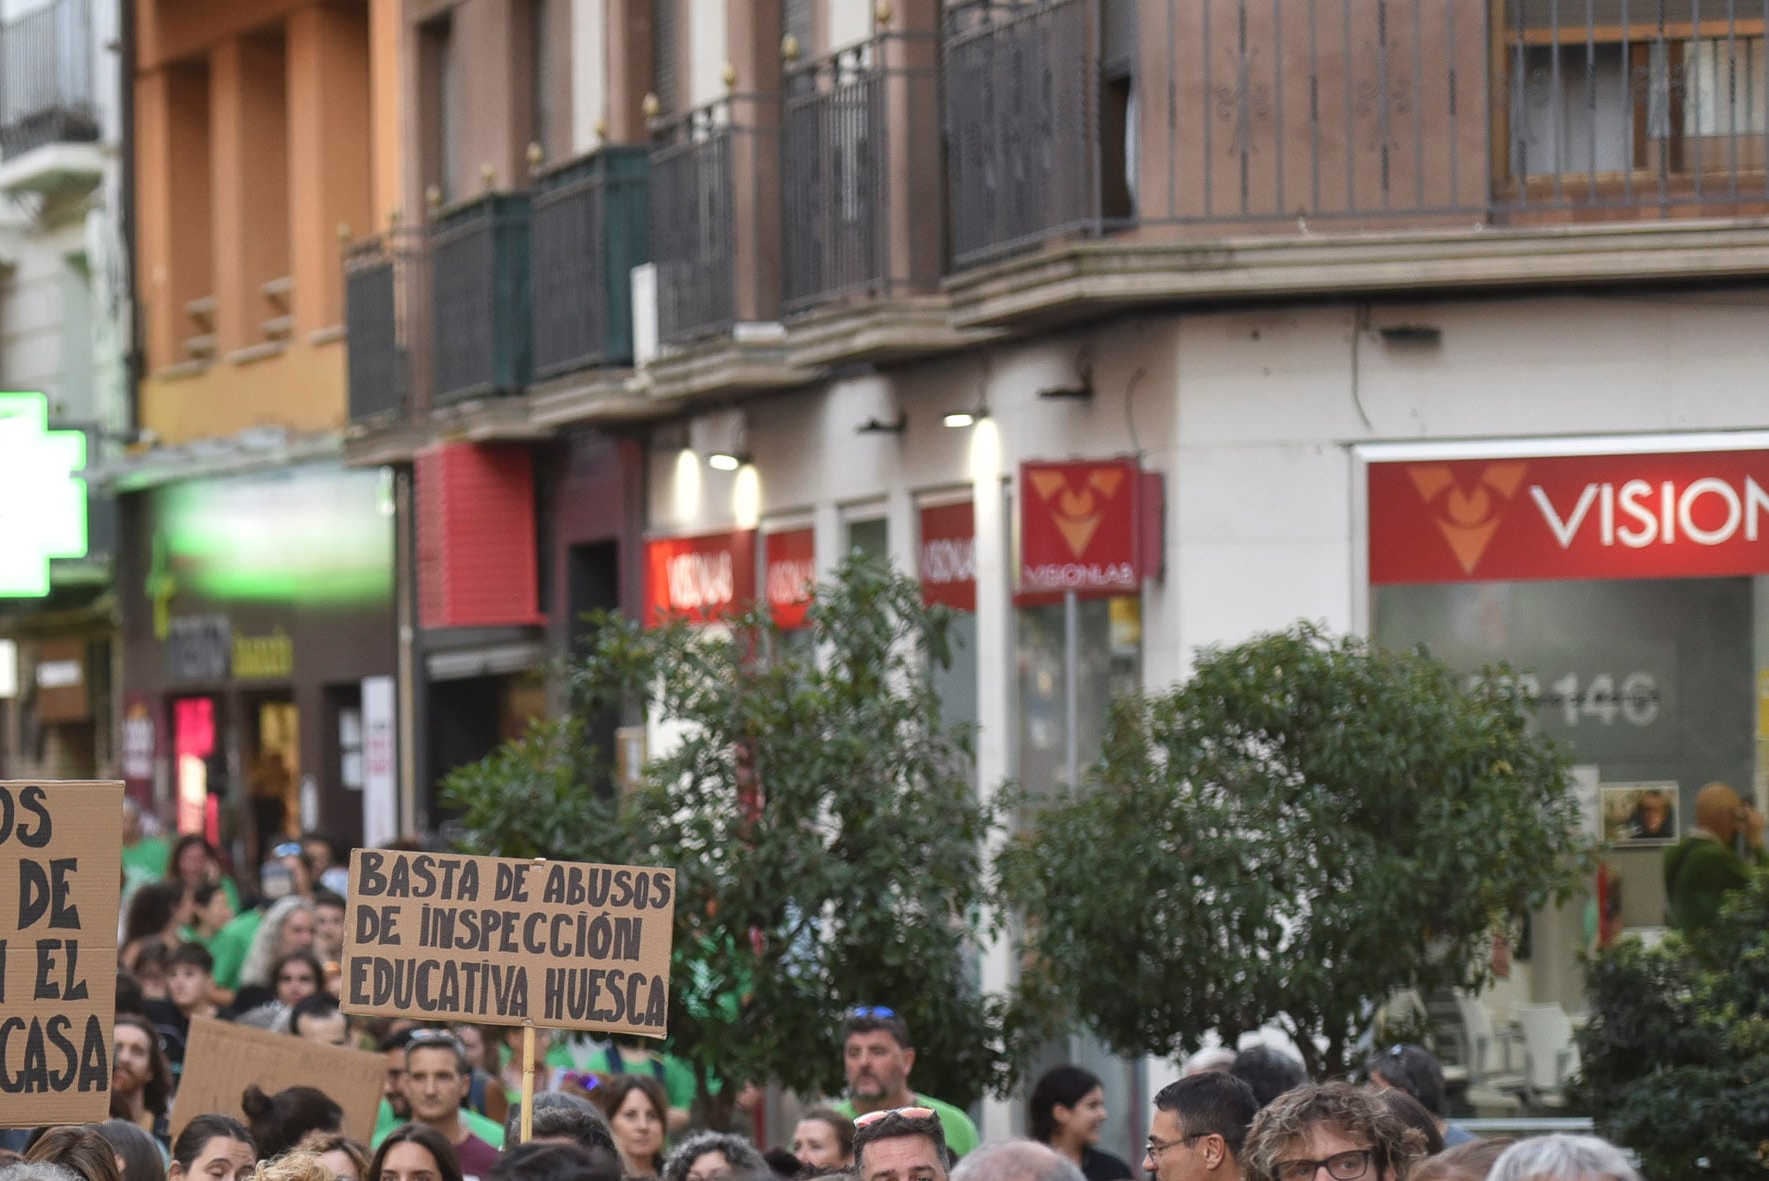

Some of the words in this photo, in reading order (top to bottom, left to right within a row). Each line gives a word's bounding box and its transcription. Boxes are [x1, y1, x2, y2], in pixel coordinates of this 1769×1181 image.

[17, 857, 82, 931] DE
[358, 851, 480, 902] BASTA
[493, 862, 531, 903] DE
[542, 863, 672, 910] ABUSOS
[355, 904, 402, 946] DE
[34, 938, 90, 1001] EL
[349, 956, 529, 1018] EDUCATIVA
[543, 967, 667, 1027] HUESCA
